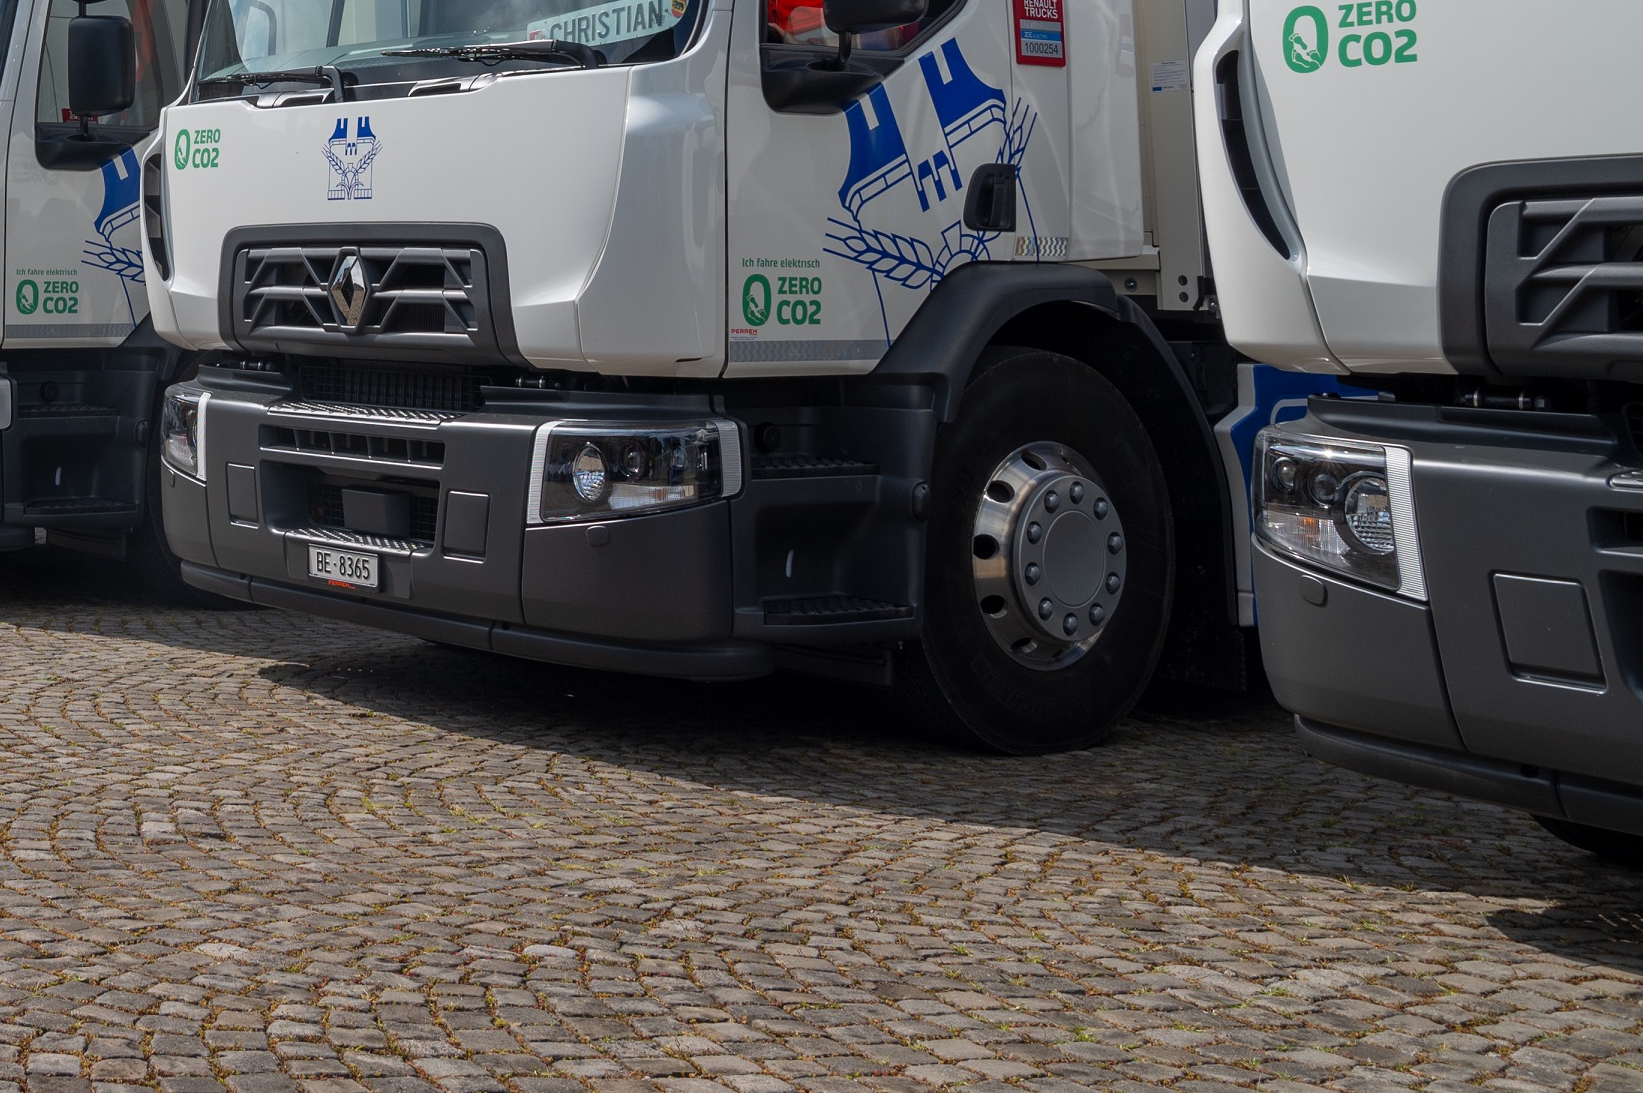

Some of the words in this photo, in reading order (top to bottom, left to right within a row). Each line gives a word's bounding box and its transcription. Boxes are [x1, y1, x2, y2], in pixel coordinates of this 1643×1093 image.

[1024, 7, 1059, 19] TRUCKS
[1025, 42, 1059, 55] 1000254
[1338, 29, 1418, 68] CO2
[194, 128, 221, 144] ZERO
[192, 147, 220, 169] CO2
[742, 258, 754, 267] Ich
[757, 258, 778, 268] fahre
[780, 258, 821, 268] elektrisch
[16, 268, 26, 276] Ich
[27, 268, 45, 276] fahre
[46, 268, 78, 276] elektrisch
[43, 281, 79, 294] ZERO
[777, 276, 822, 295] ZERO
[42, 296, 79, 314] CO2
[776, 299, 822, 326] CO2
